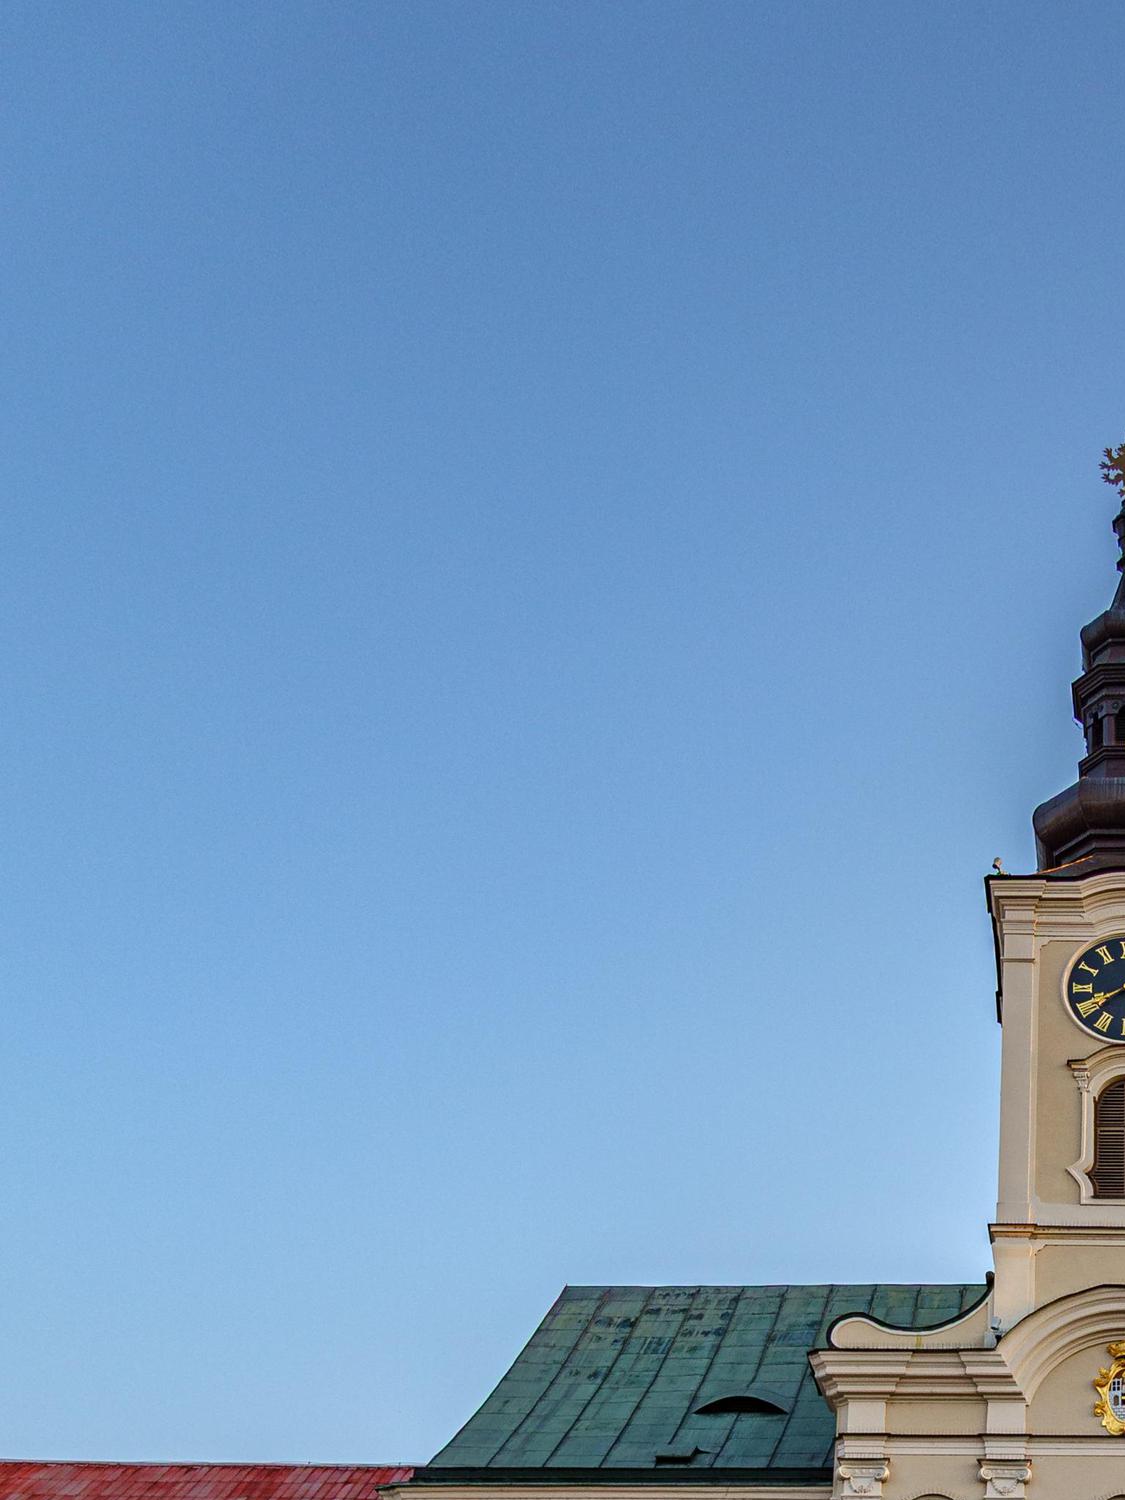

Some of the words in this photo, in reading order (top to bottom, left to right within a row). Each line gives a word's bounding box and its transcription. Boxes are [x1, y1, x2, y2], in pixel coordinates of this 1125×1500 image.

[1095, 945, 1115, 965] XI
[1078, 961, 1099, 977] X
[1072, 982, 1093, 994] IX
